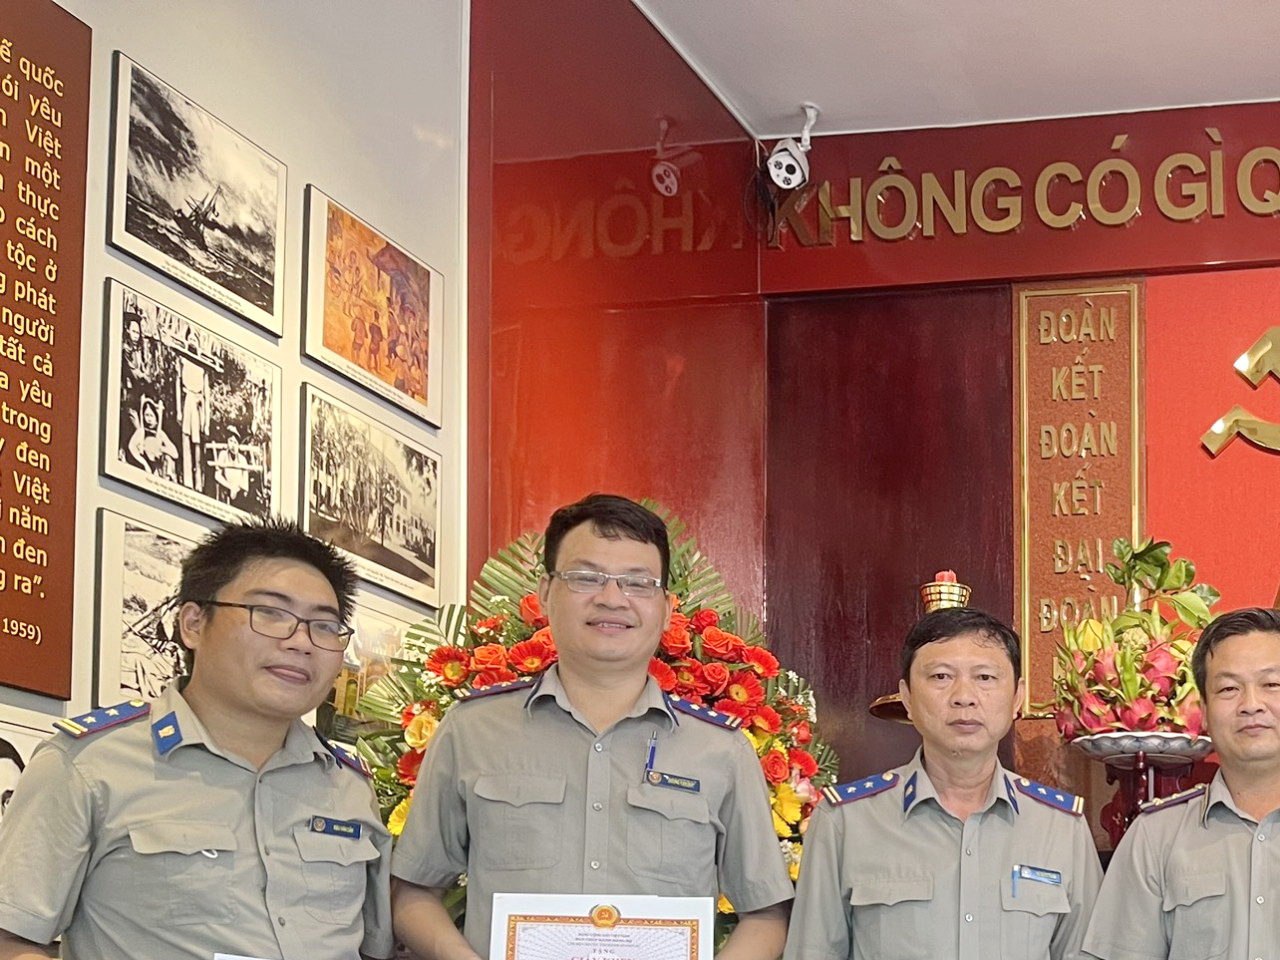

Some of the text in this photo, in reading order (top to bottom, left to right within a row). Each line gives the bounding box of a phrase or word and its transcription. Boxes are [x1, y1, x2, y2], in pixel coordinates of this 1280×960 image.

[19, 57, 64, 97] quốc
[29, 93, 62, 128] yêu
[25, 119, 62, 160] Việt
[25, 155, 61, 190] một
[768, 156, 1023, 248] KHÔNG
[1035, 134, 1142, 229] CÓ
[1154, 127, 1226, 221] GÌ
[17, 180, 60, 221] thực
[15, 216, 57, 251] cách
[6, 239, 57, 282] tộc ở
[15, 279, 56, 315] phát
[2, 306, 54, 345] người
[1038, 298, 1117, 345] ĐOÀN
[32, 352, 53, 377] cả
[1051, 347, 1105, 401] KẾT
[19, 379, 52, 409] yêu
[1, 401, 51, 444] trong
[1039, 409, 1119, 459] ĐOÀN
[15, 441, 50, 472] đen
[13, 470, 50, 504] Việt
[1052, 462, 1105, 517] KẾT
[9, 505, 48, 535] năm
[13, 538, 47, 567] đen
[1053, 538, 1104, 581] ĐẠI
[2, 617, 42, 645] 1959)
